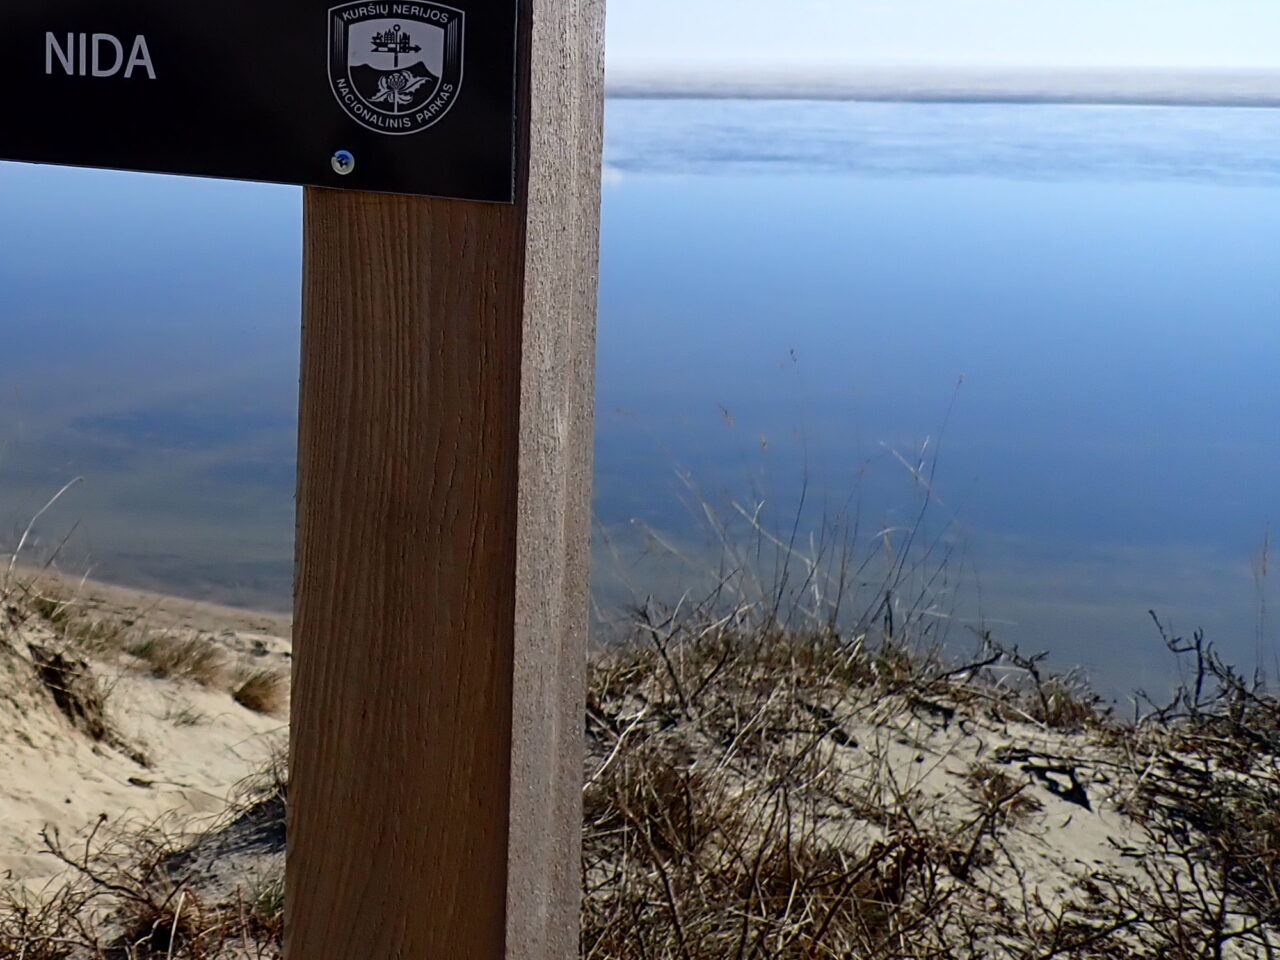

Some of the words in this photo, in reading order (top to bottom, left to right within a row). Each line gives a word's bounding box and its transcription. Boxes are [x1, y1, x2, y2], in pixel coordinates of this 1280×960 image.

[342, 3, 389, 22] KURŠIŲ
[392, 4, 449, 23] NERIJOS
[44, 31, 157, 79] NIDA
[336, 78, 412, 128] NACIONALINIS
[415, 83, 453, 123] PARKAS
